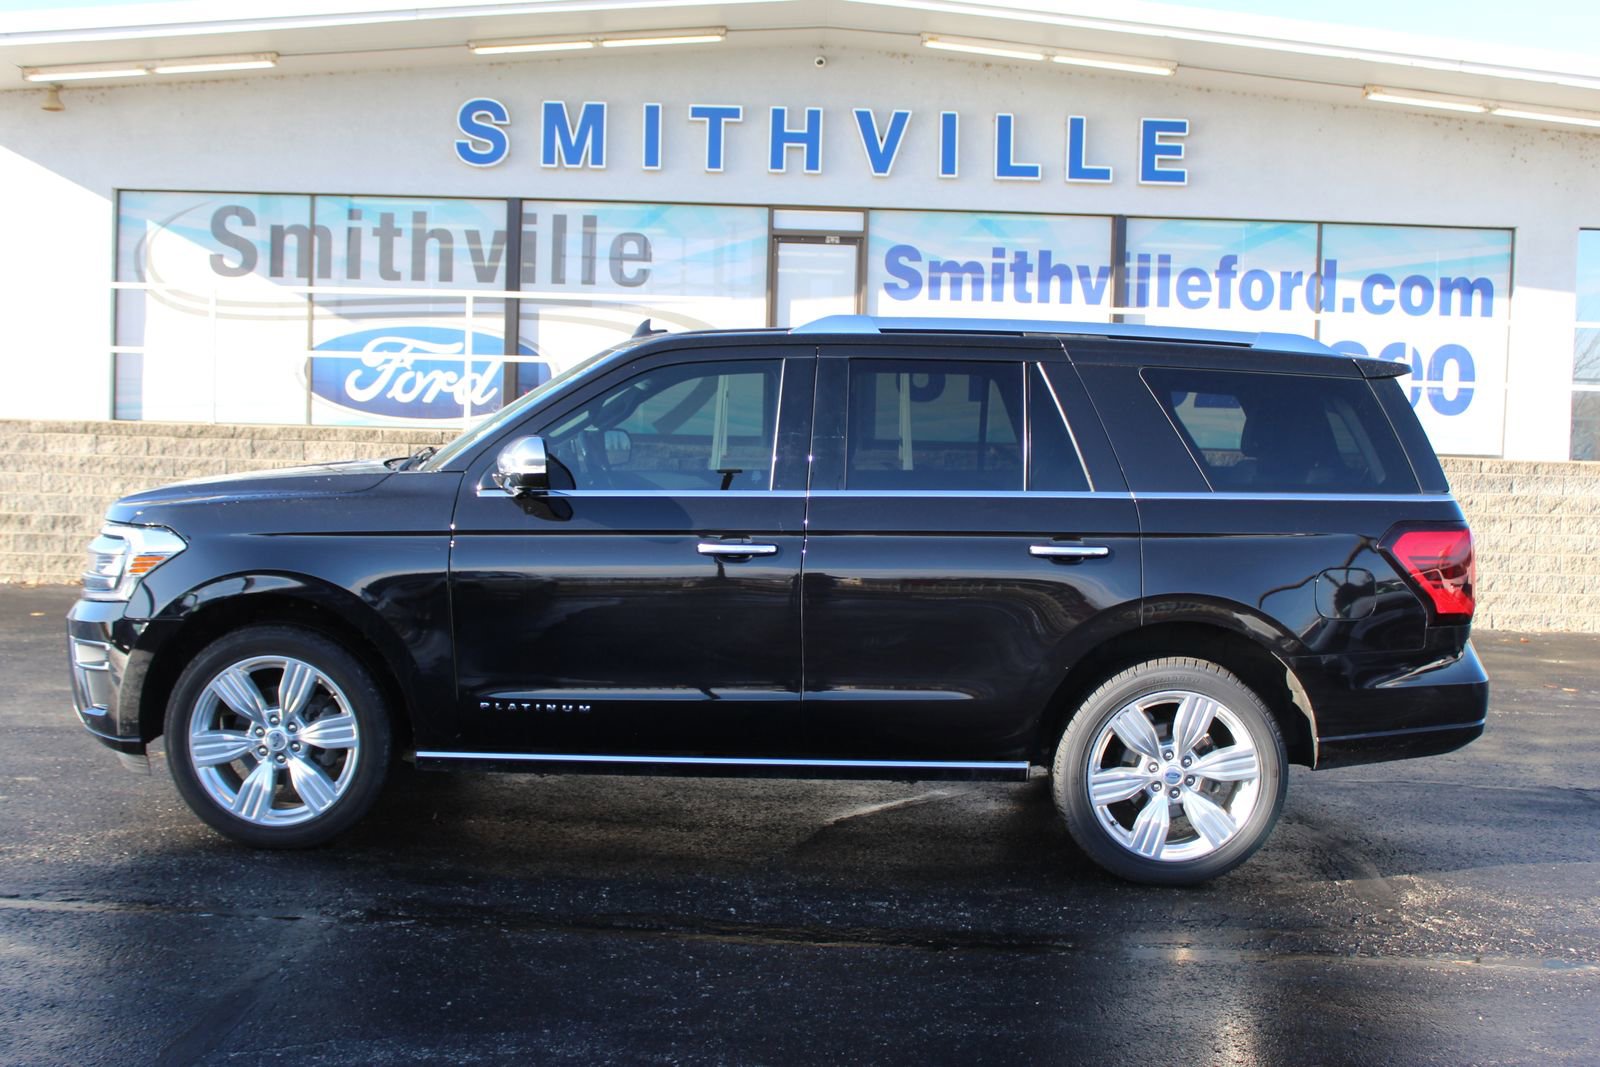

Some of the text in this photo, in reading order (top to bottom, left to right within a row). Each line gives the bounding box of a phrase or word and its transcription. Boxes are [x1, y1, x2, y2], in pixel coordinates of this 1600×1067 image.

[455, 97, 1191, 187] SMITHVILLE
[210, 205, 652, 288] Smithville
[345, 336, 503, 406] Ford
[480, 702, 591, 712] PLATINUM
